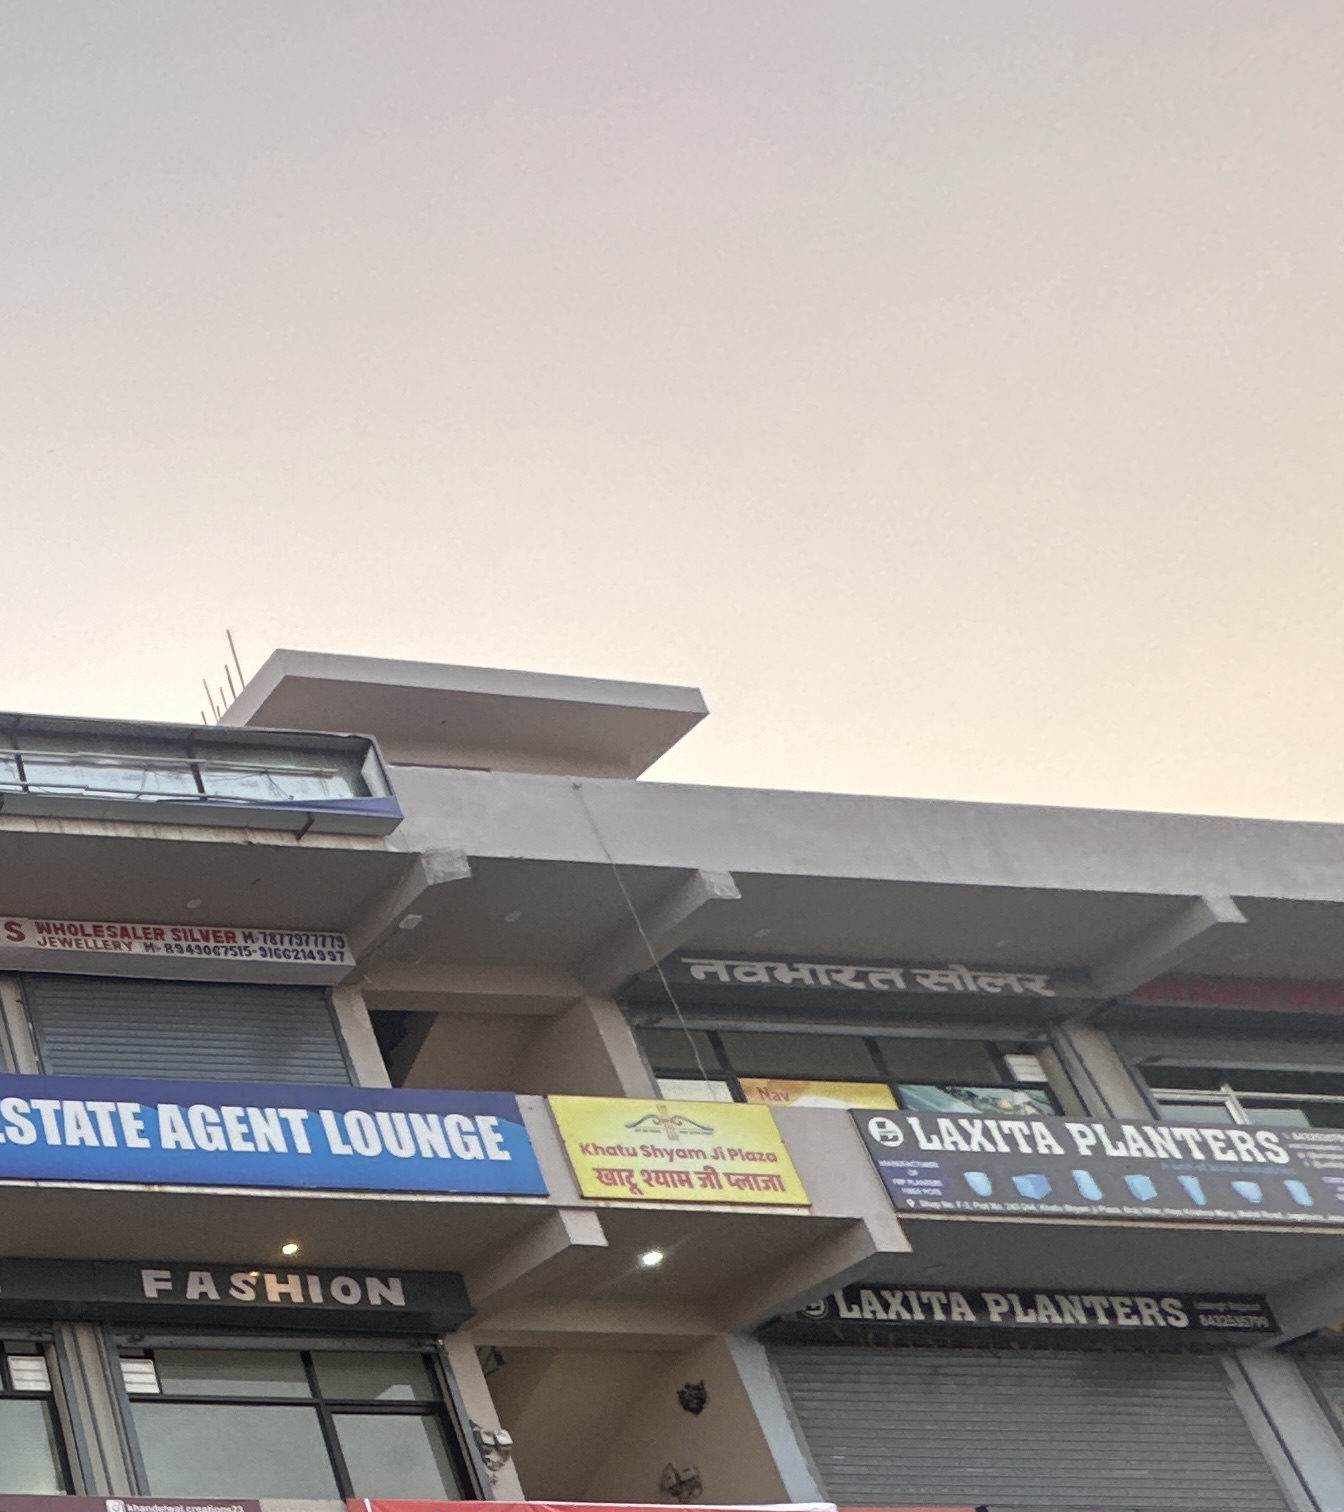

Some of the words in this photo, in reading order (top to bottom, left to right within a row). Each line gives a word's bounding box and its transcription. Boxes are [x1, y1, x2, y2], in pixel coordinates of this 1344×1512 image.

[35, 921, 165, 942] WHOLESALER
[172, 928, 237, 944] SILVER
[37, 936, 133, 952] JEWELLERY
[681, 957, 908, 990] नवभारत
[915, 963, 1057, 998] सोलर
[157, 1103, 313, 1154] AGENT
[319, 1109, 513, 1161] LOUNGE
[906, 1116, 1065, 1155] LAXITA
[1065, 1122, 1290, 1164] PLANTERS
[579, 1142, 637, 1157] Khatu
[641, 1144, 707, 1162] Shyam
[711, 1145, 728, 1161] Ji
[729, 1148, 778, 1163] Plaza
[592, 1167, 644, 1195] खाटू
[641, 1169, 694, 1189] श्याम
[694, 1166, 724, 1190] जी
[723, 1172, 787, 1192] प्लाजा
[140, 1269, 406, 1306] FASHION
[835, 1290, 977, 1323] LAXITA
[980, 1293, 1190, 1329] PLANTERS
